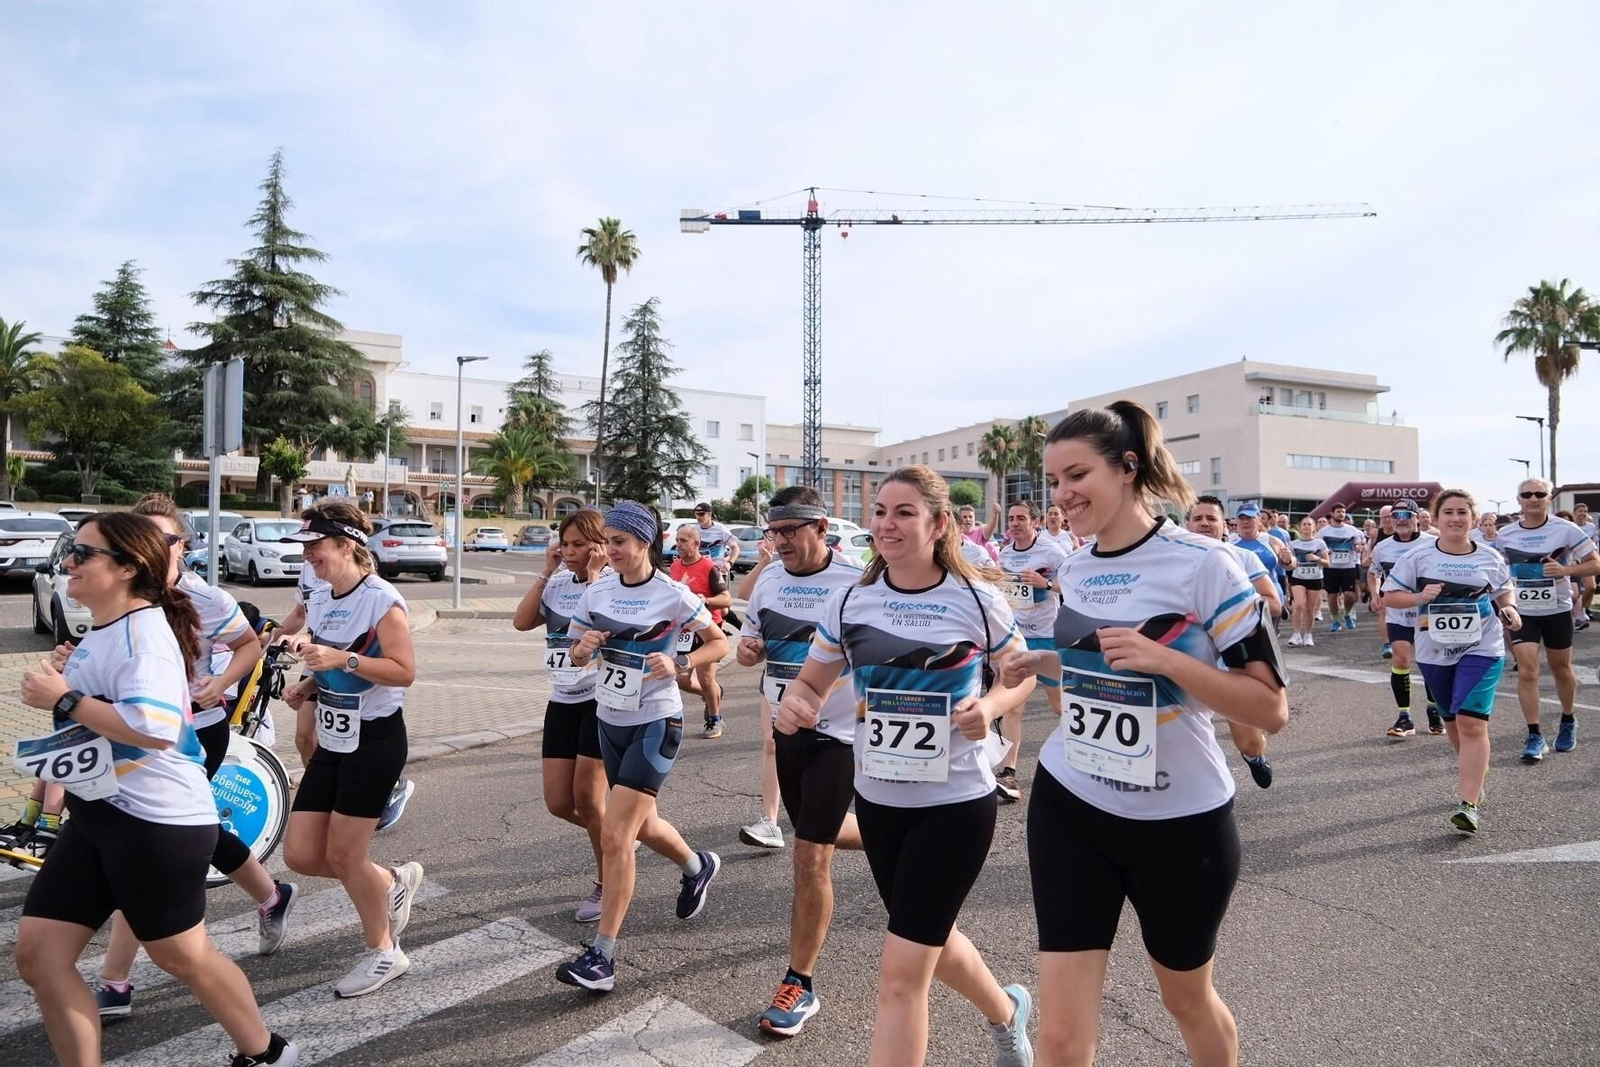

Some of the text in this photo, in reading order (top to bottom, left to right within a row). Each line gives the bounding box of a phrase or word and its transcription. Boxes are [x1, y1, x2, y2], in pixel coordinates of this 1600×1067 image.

[1376, 488, 1429, 498] IMDECO
[783, 586, 830, 597] CARRERA
[1519, 590, 1551, 600] 626
[903, 619, 931, 627] SALUD
[1435, 616, 1474, 630] 607
[547, 652, 576, 668] 47
[603, 666, 627, 689] 73
[1100, 685, 1147, 698] INVESTIGACIÓN
[1069, 702, 1140, 747] 370
[869, 718, 937, 751] 372
[26, 746, 99, 779] 769
[234, 773, 252, 786] 2012
[212, 774, 256, 803] Santiago
